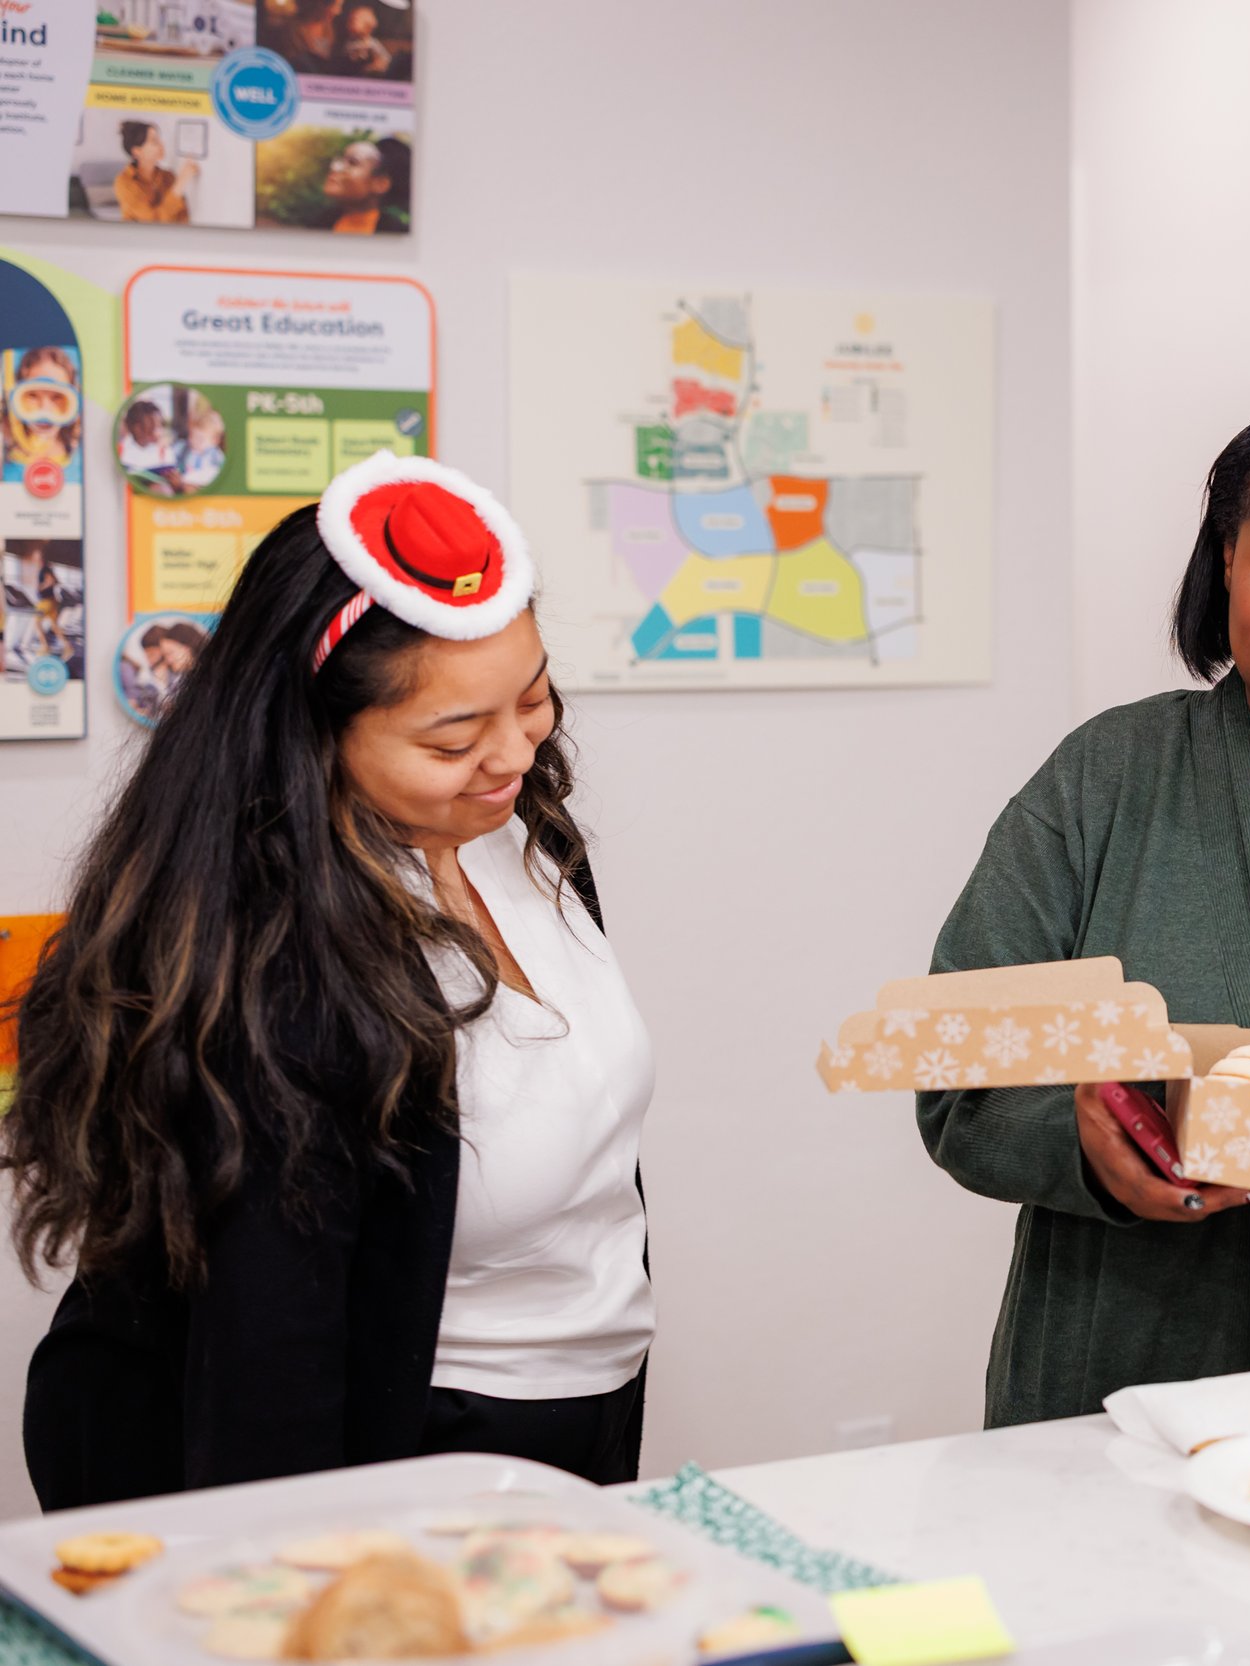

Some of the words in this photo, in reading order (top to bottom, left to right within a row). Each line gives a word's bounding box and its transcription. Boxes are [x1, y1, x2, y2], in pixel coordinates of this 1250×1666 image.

[2, 20, 47, 46] ind
[233, 85, 277, 105] WELL
[182, 309, 252, 332] Great
[261, 313, 384, 336] Education
[247, 390, 325, 415] PK-5th
